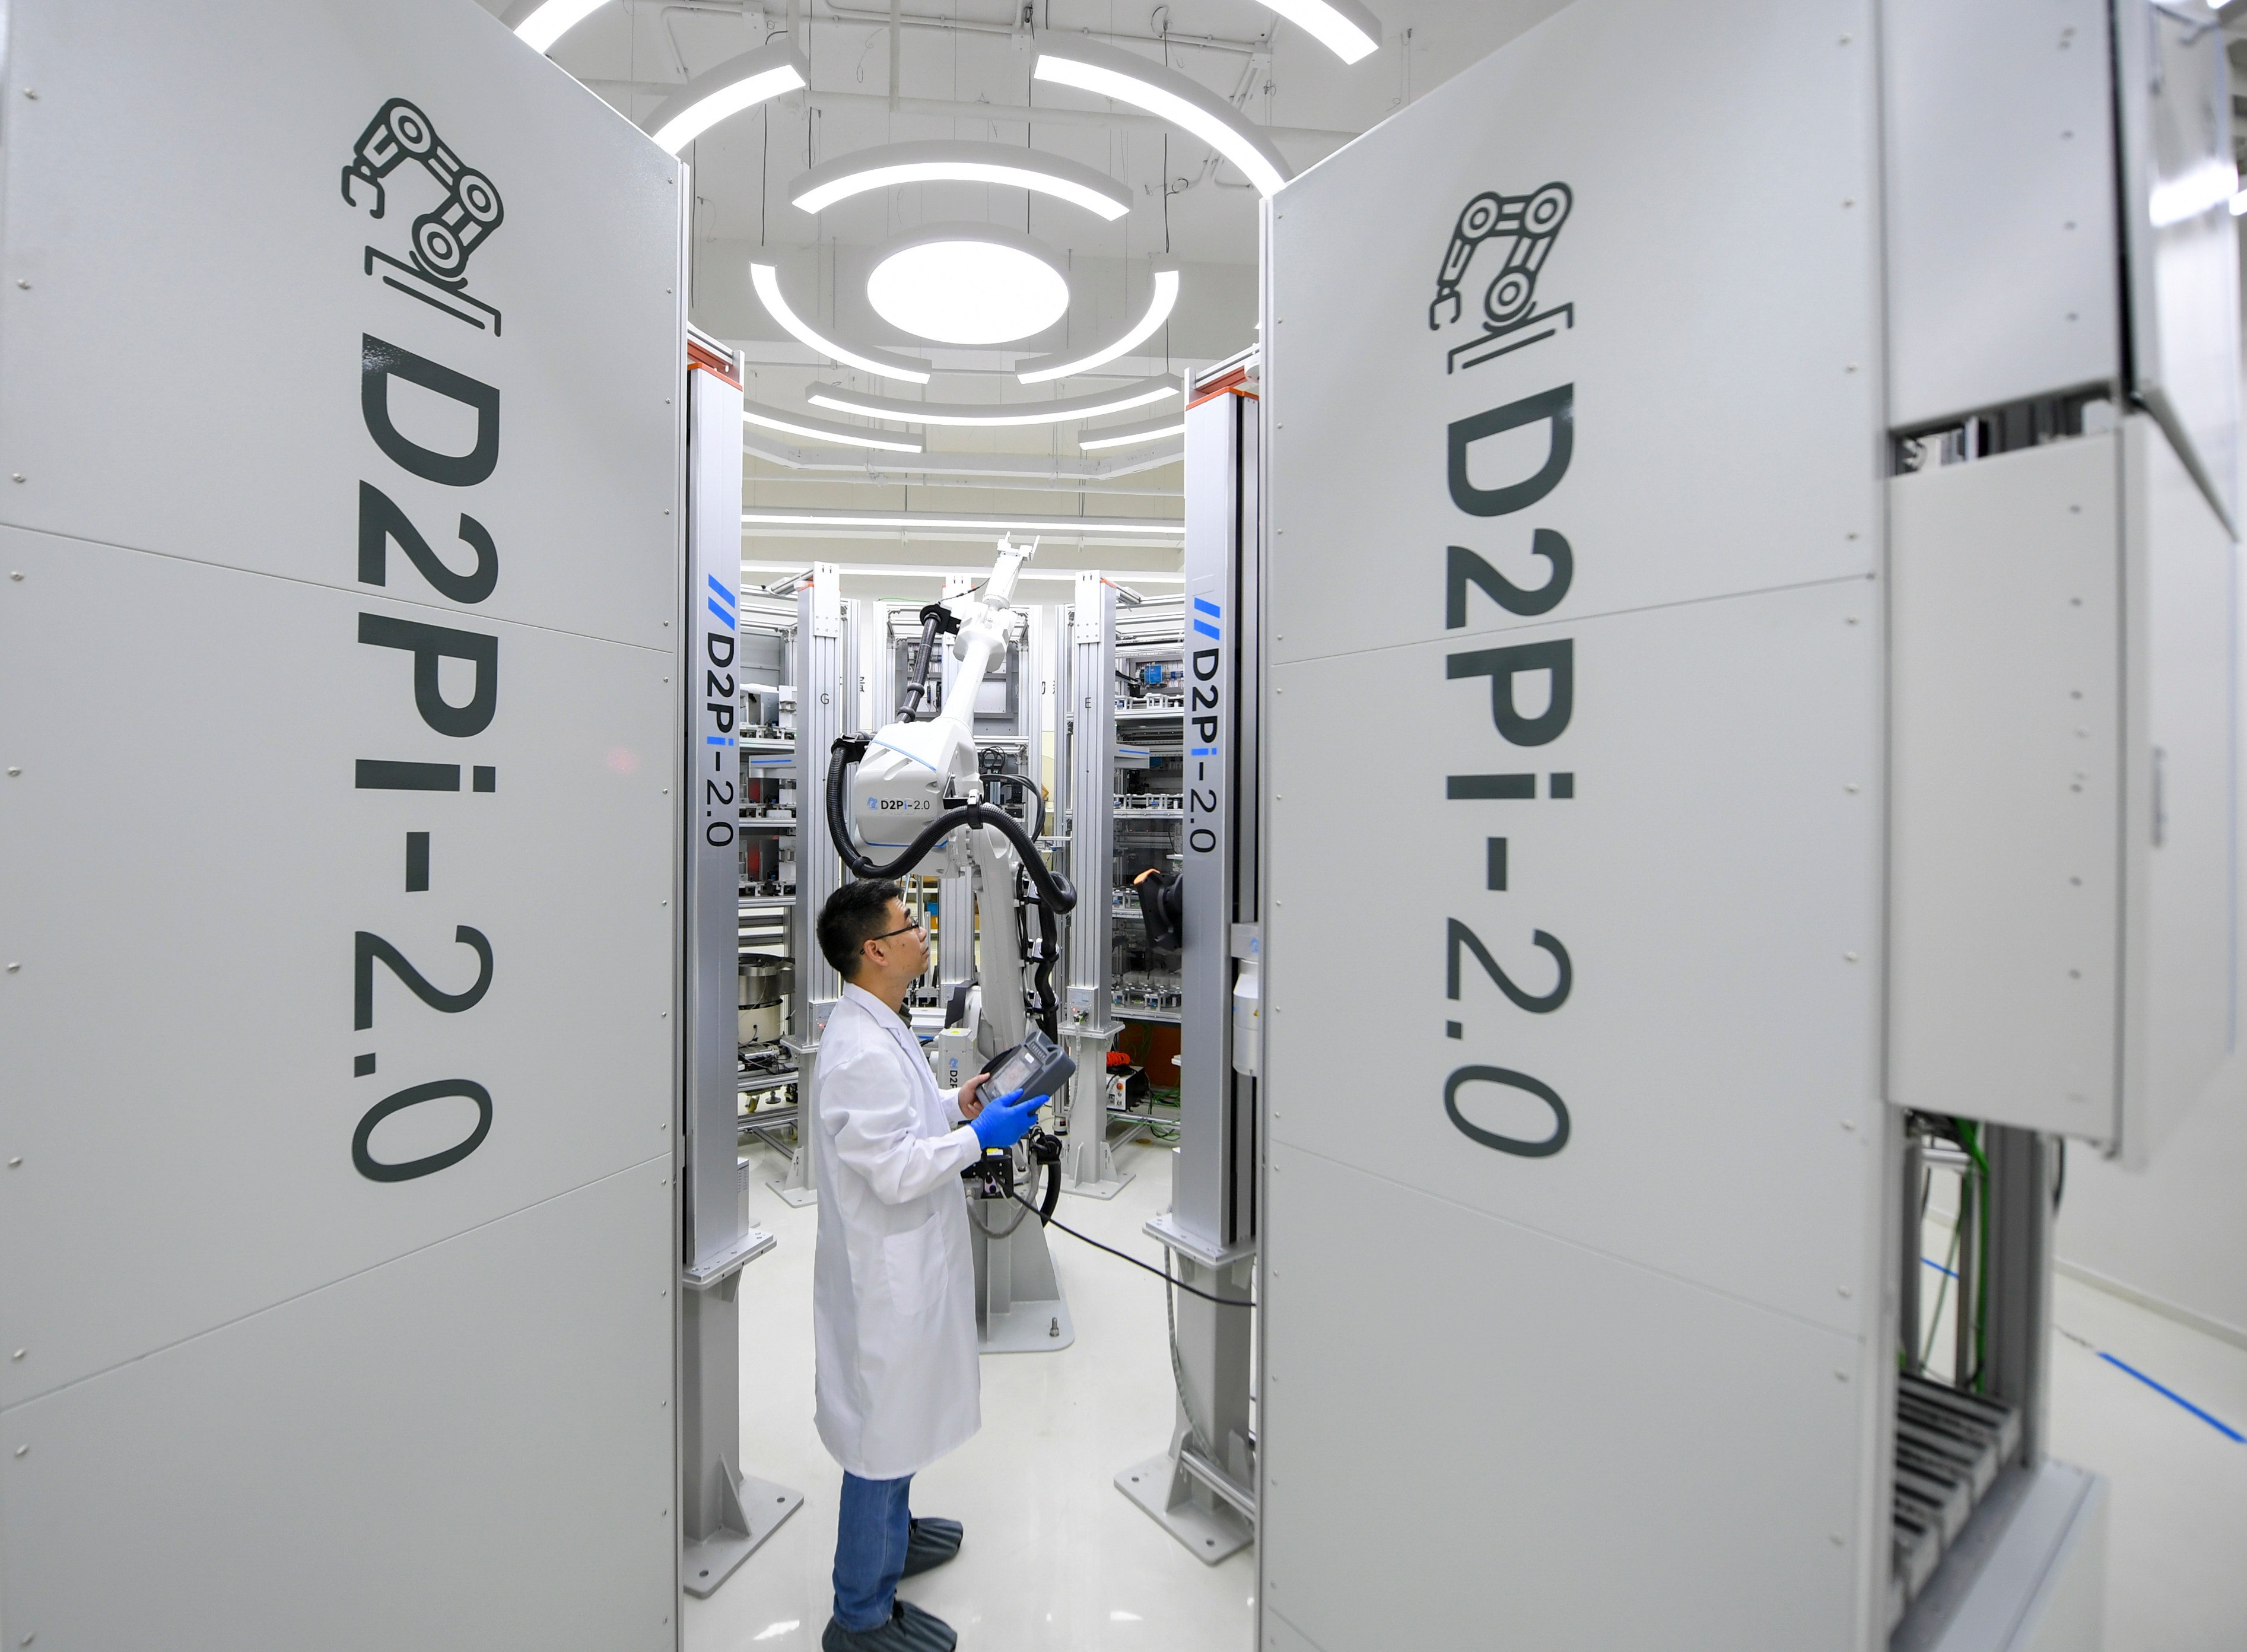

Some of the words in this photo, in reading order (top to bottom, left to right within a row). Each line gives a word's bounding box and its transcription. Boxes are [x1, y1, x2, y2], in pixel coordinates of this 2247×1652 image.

[351, 332, 501, 1184] D2Pi-2.0
[706, 631, 735, 847] D2Pi-2.0
[820, 693, 829, 705] G
[1085, 697, 1092, 709] E
[1189, 647, 1220, 853] D2Pi-2.0
[1444, 383, 1574, 1158] D2Pi-2.0
[881, 800, 930, 810] D2Pi-2.0
